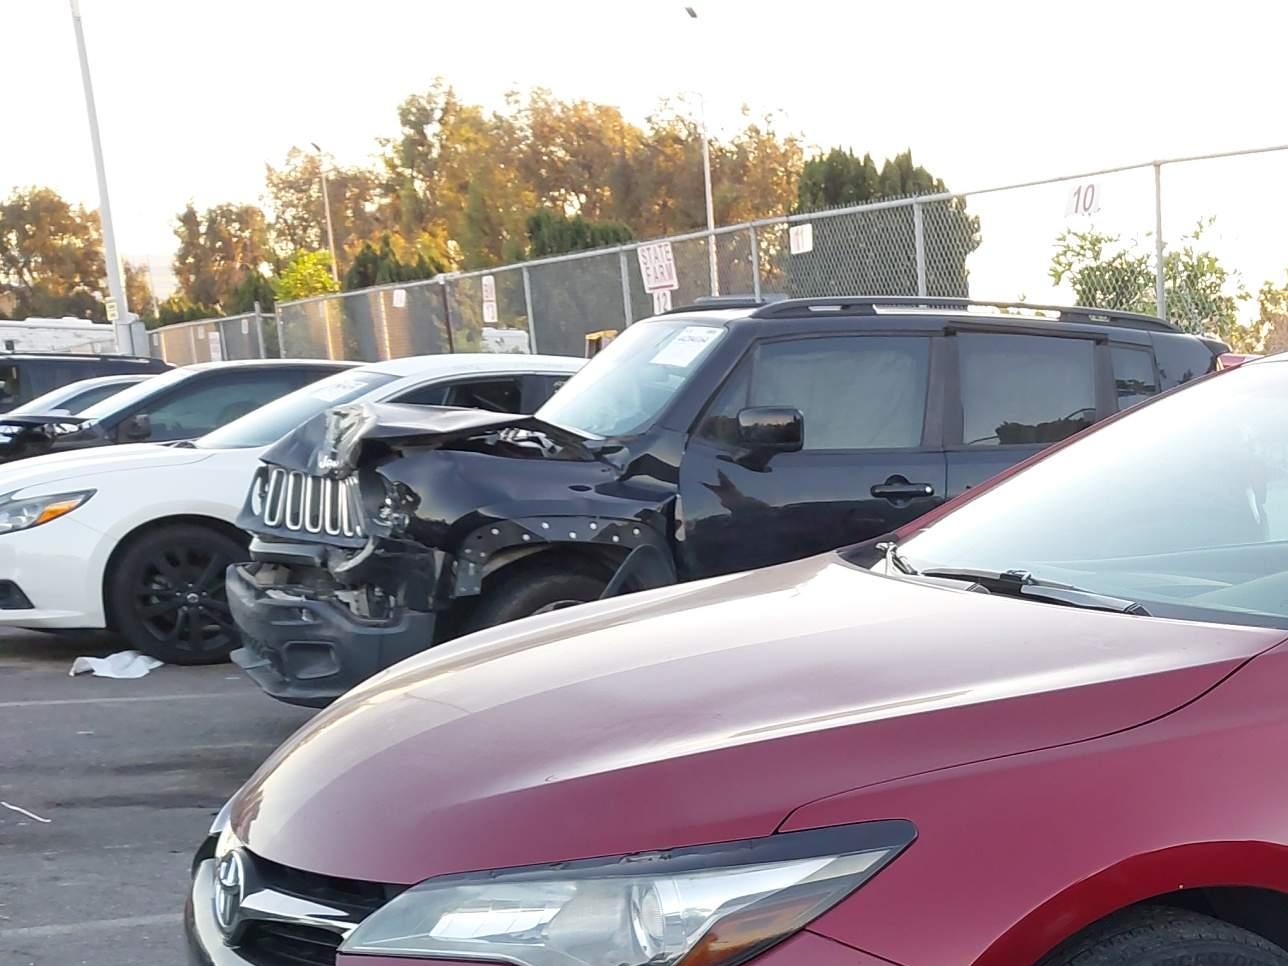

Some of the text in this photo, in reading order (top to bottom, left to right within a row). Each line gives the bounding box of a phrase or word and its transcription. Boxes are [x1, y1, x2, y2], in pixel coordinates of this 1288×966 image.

[1073, 183, 1095, 214] 10
[640, 243, 672, 267] STATE
[645, 262, 674, 282] FARM
[656, 291, 669, 313] 12
